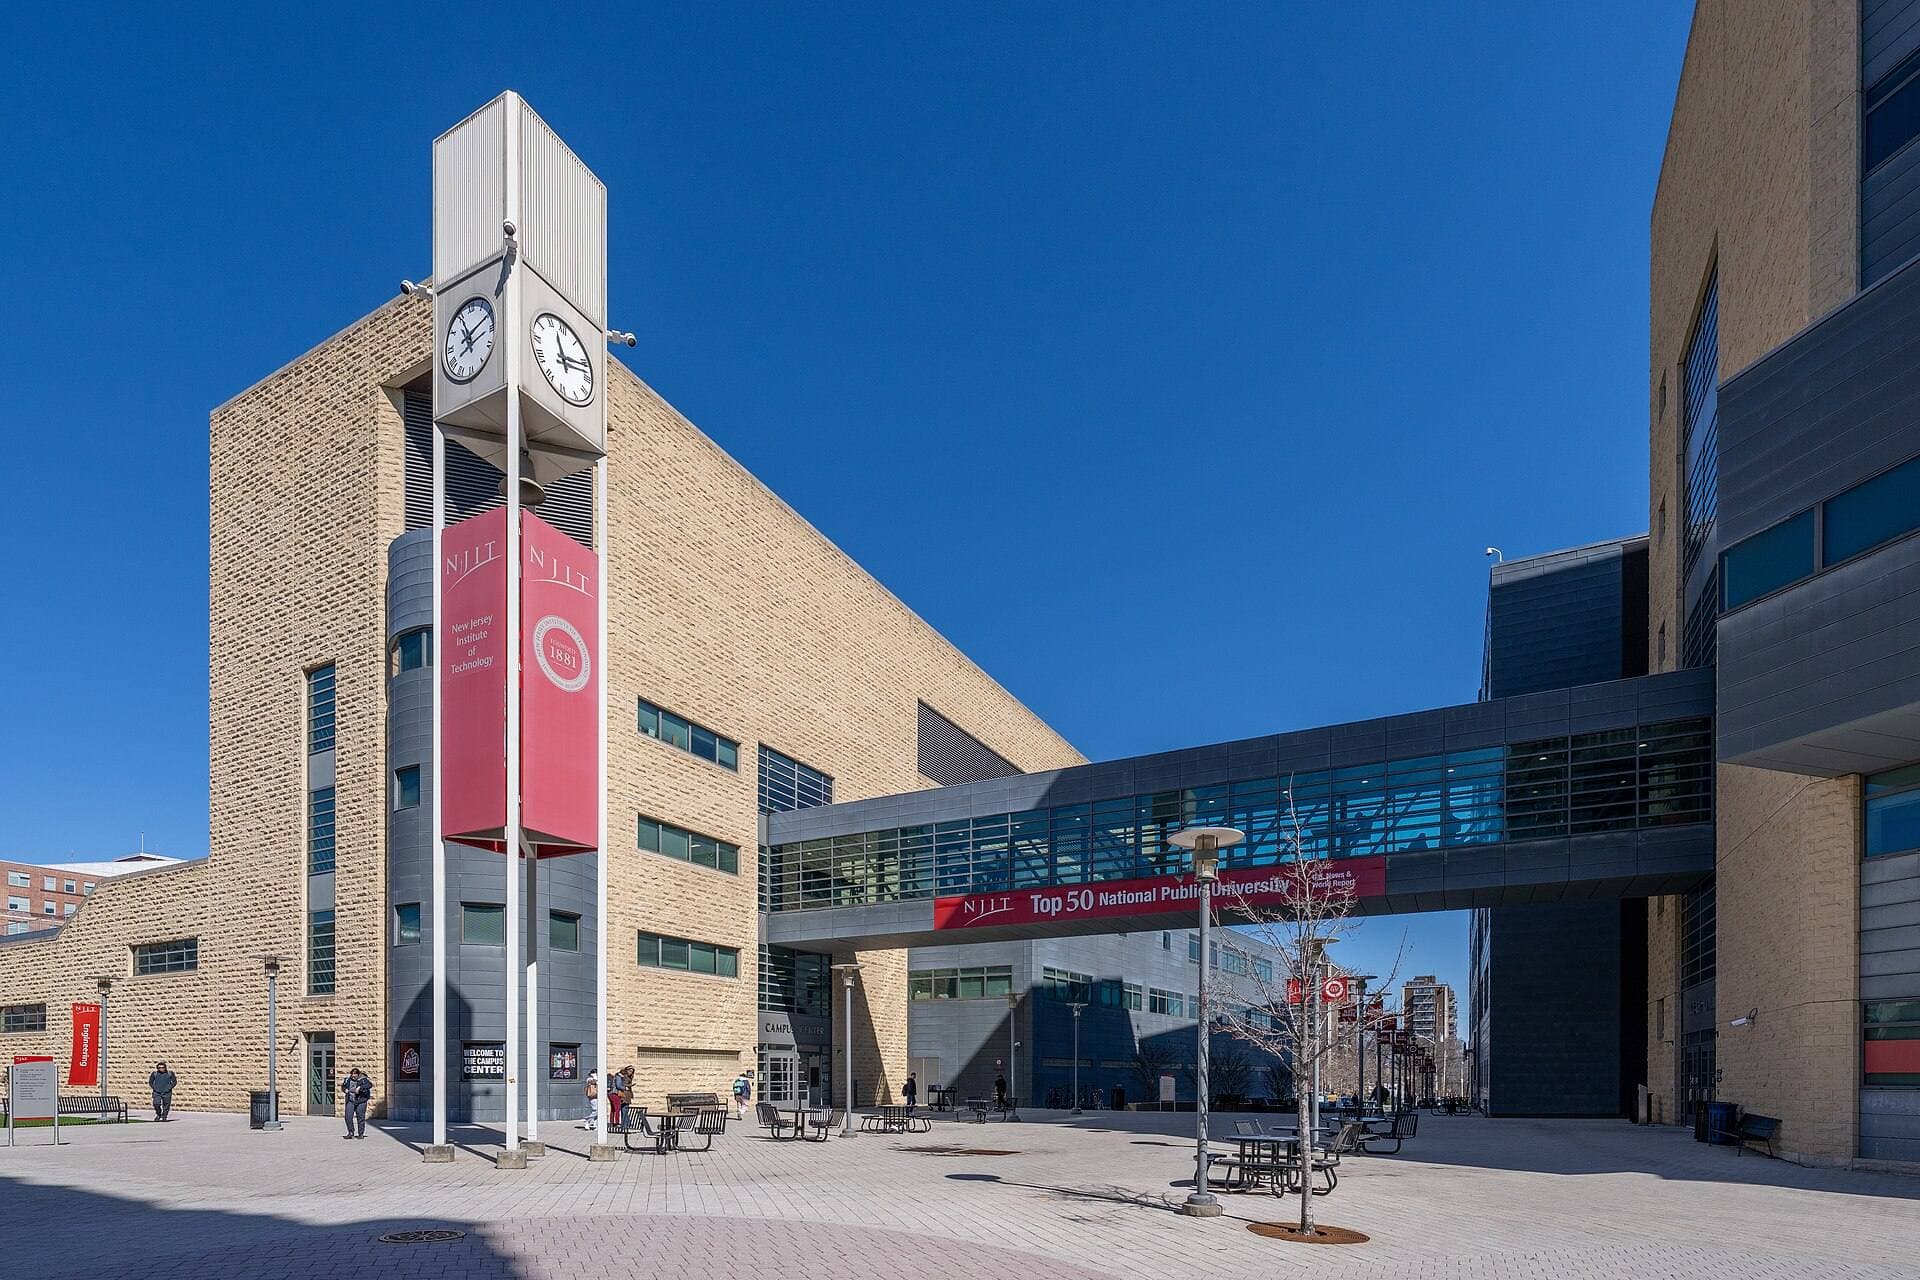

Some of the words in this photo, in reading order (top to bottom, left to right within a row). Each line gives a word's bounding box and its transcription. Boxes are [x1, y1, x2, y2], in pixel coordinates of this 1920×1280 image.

[446, 541, 496, 574] NJIT
[529, 544, 590, 593] NJIT
[451, 622, 469, 634] New
[470, 615, 493, 628] Jersey
[456, 630, 488, 646] Institute
[468, 646, 477, 657] of
[550, 646, 576, 668] 1881
[450, 655, 494, 674] Technology
[964, 897, 1011, 914] NJIT
[1030, 894, 1062, 917] Top
[1066, 889, 1094, 912] 50
[1099, 887, 1156, 906] National
[1211, 877, 1289, 897] University
[80, 1023, 91, 1067] Engineering
[464, 1049, 494, 1057] WELCOME
[495, 1049, 504, 1057] TO
[464, 1057, 476, 1065] THE
[477, 1057, 504, 1065] CAMPUS
[464, 1065, 504, 1074] CENTER
